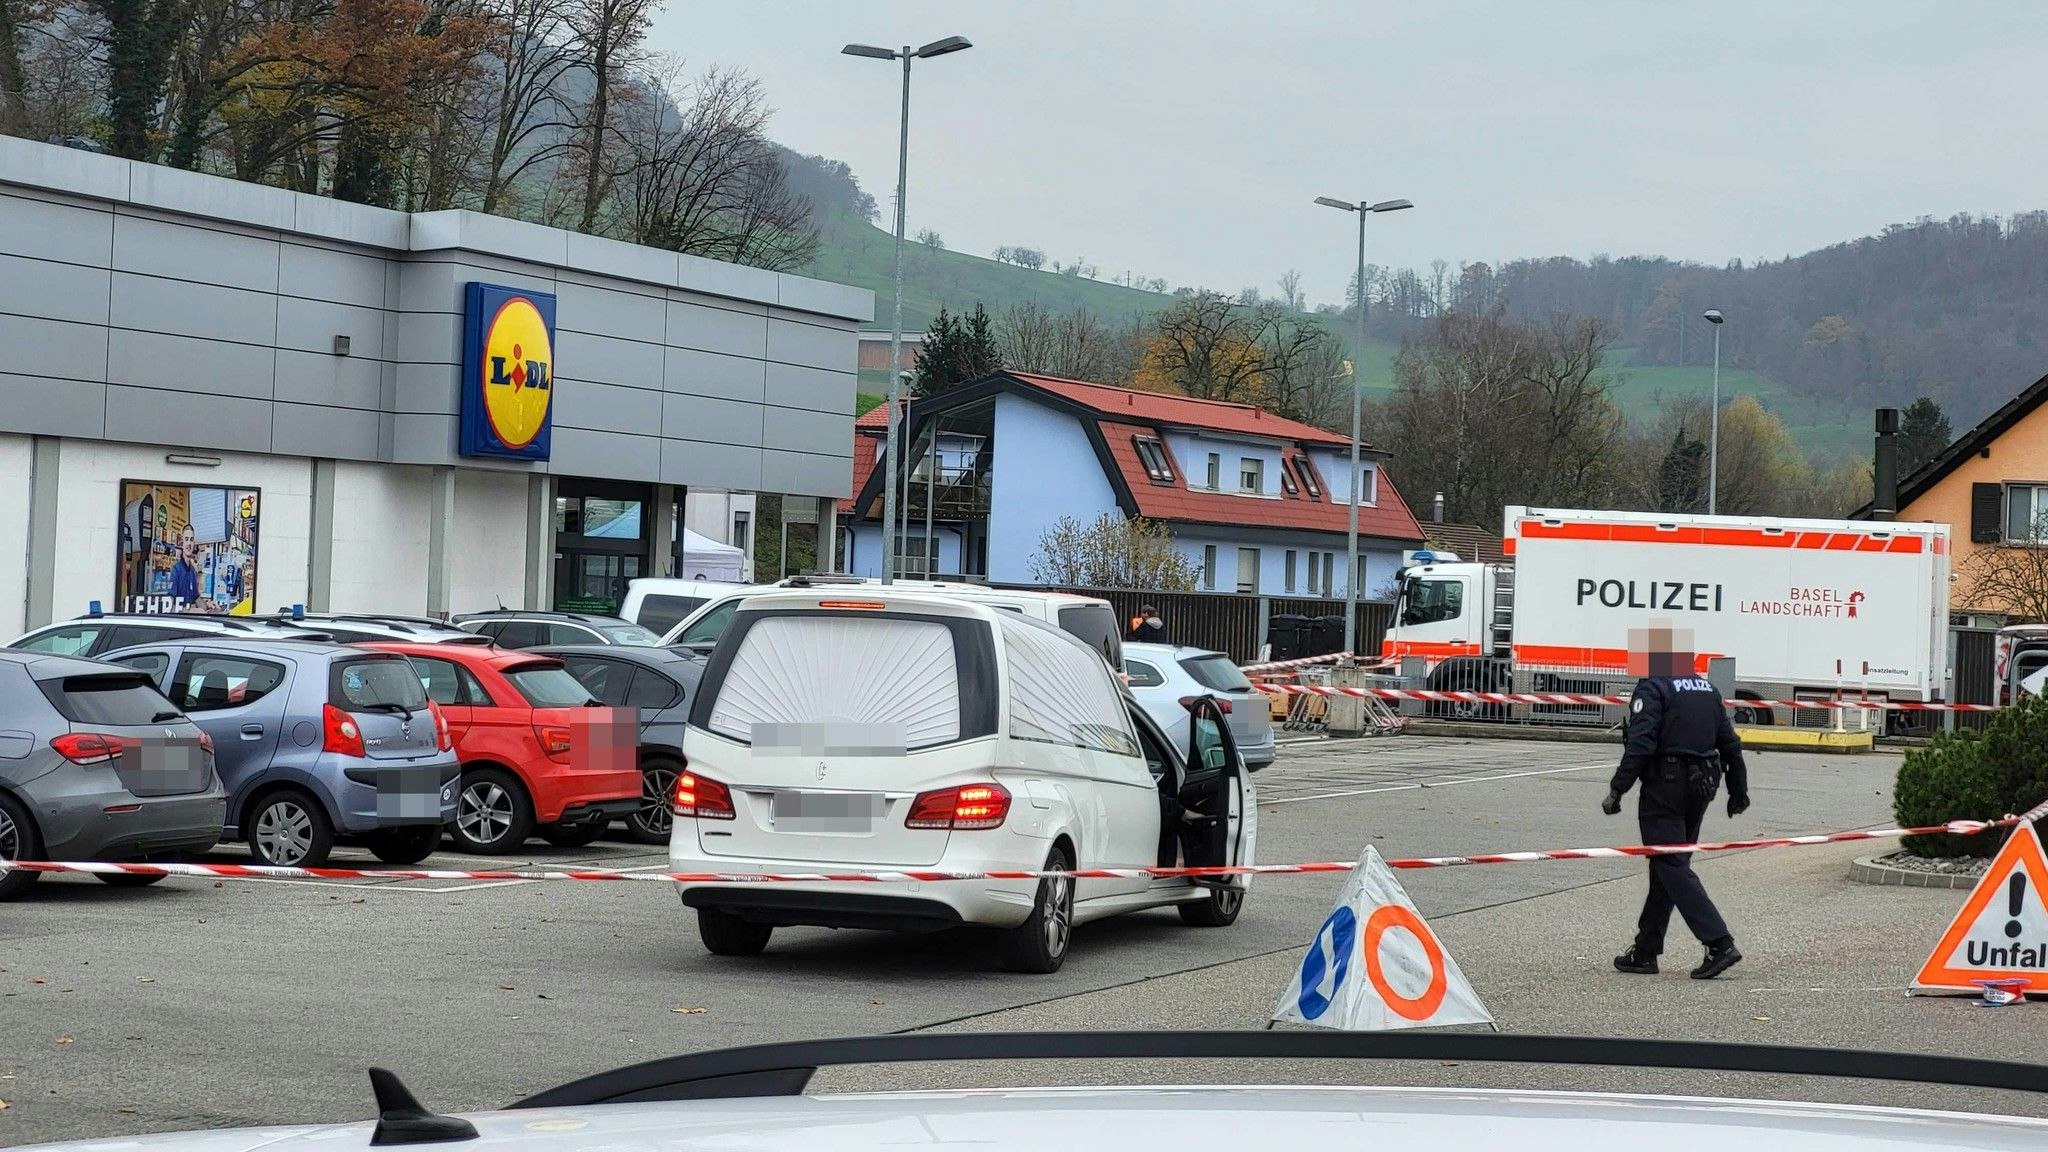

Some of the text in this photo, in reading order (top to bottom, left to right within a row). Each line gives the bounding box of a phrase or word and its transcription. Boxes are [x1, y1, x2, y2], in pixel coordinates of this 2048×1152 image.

[490, 344, 550, 393] LIDL
[1577, 578, 1722, 612] POLIZEI
[1790, 587, 1842, 603] BASEL
[1740, 600, 1842, 618] LANDSCHAFT
[1673, 679, 1713, 692] POLIZE
[1967, 940, 2047, 968] Unfal
